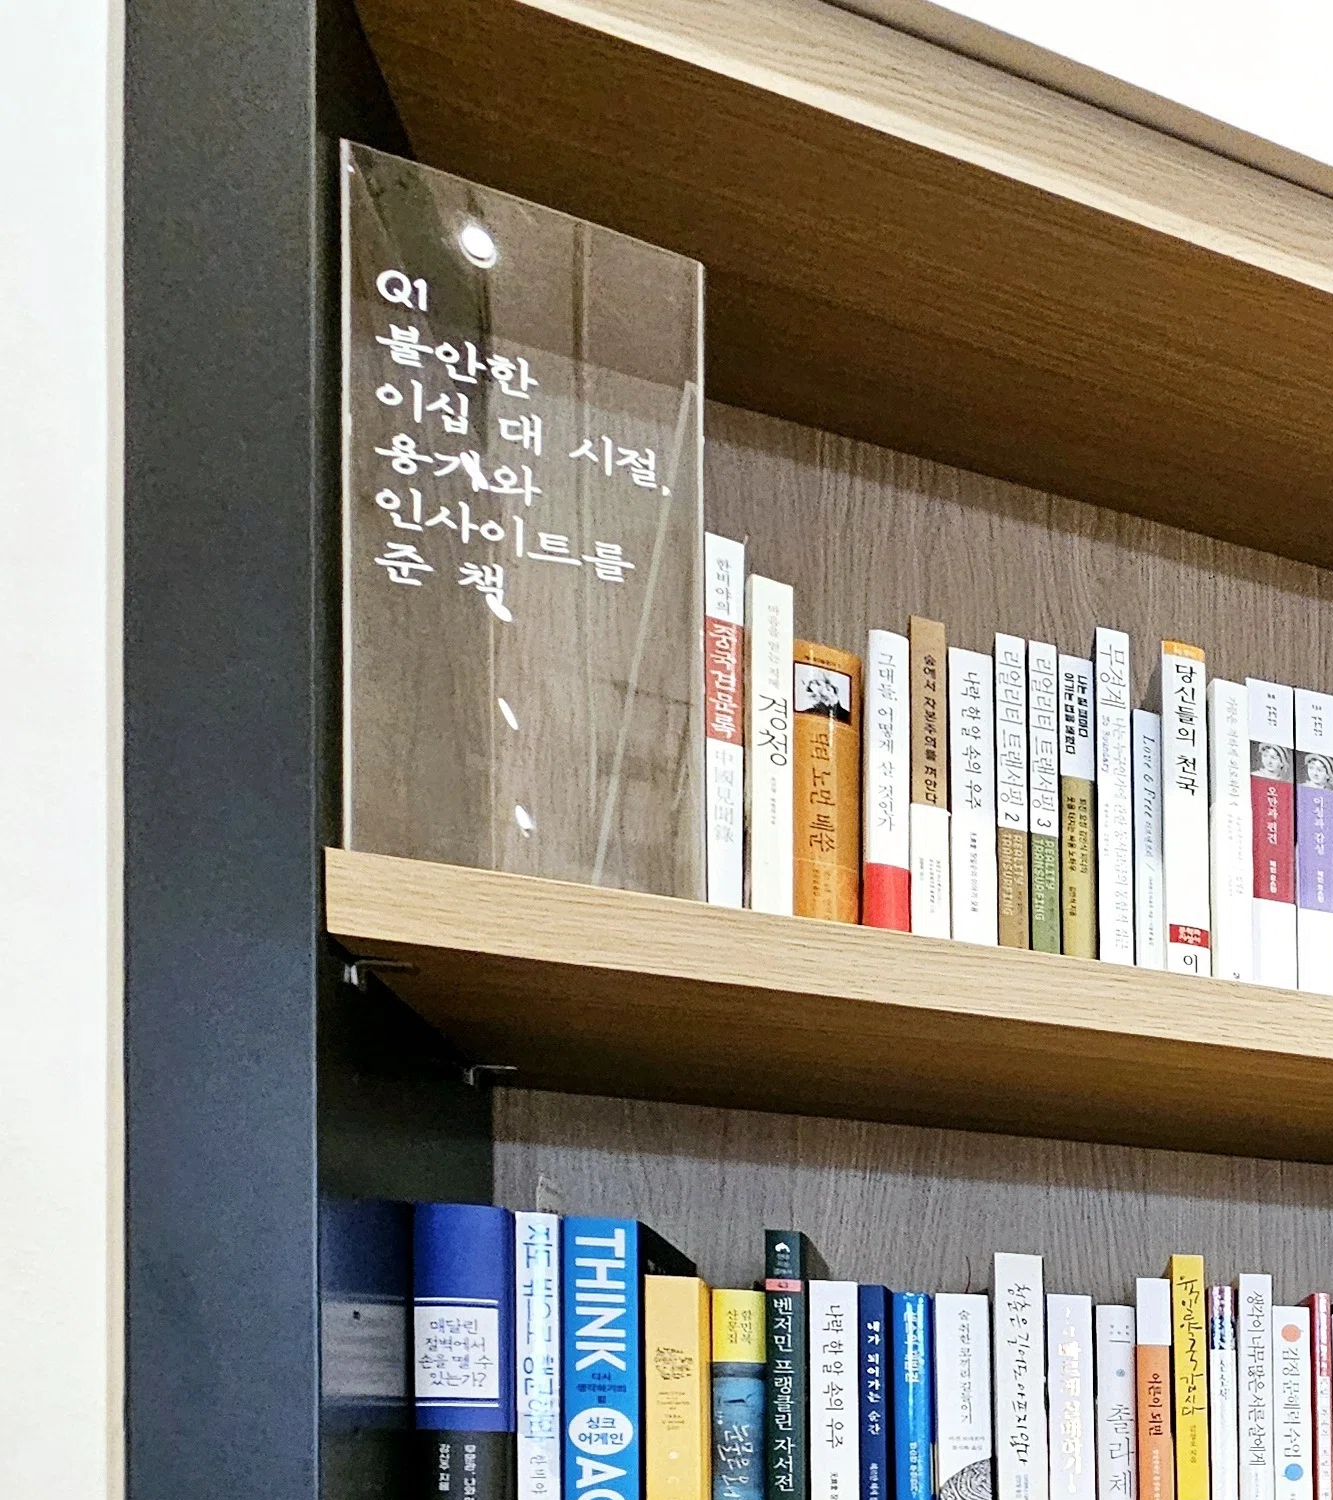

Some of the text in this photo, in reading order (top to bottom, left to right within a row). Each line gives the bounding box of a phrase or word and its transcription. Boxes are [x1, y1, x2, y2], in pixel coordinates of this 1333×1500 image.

[375, 269, 430, 313] Q1
[375, 325, 539, 400] 불안한
[376, 379, 470, 435] 이십
[499, 413, 544, 456] 대
[375, 432, 542, 506] 용기와
[375, 542, 508, 605] 준 책
[376, 485, 635, 584] 인사이트를
[1100, 644, 1127, 710] 무경계
[961, 671, 982, 810] 나락 한 알 속의 우주
[999, 651, 1022, 824] 리얼리티 트랜서핑 2
[1030, 658, 1054, 829] 리얼리티 트랜서핑 3
[1175, 664, 1199, 796] 당신들의 천국
[428, 1317, 479, 1335] 매달린
[575, 1228, 626, 1371] THINK
[424, 1335, 487, 1353] 절벽에서
[822, 1304, 846, 1449] 나락 한 알 속의 우주
[1246, 1290, 1268, 1466] 생각이 너무 많은 서른 살에게
[578, 1430, 624, 1447] 어게인
[584, 1415, 617, 1431] 싱크
[774, 1298, 796, 1493] 벤저민 프랭클린 자서전
[1147, 1372, 1163, 1437] 어른이 되면
[1283, 1348, 1302, 1459] 감정 문해력 수업
[1106, 1403, 1135, 1499] 촐라체
